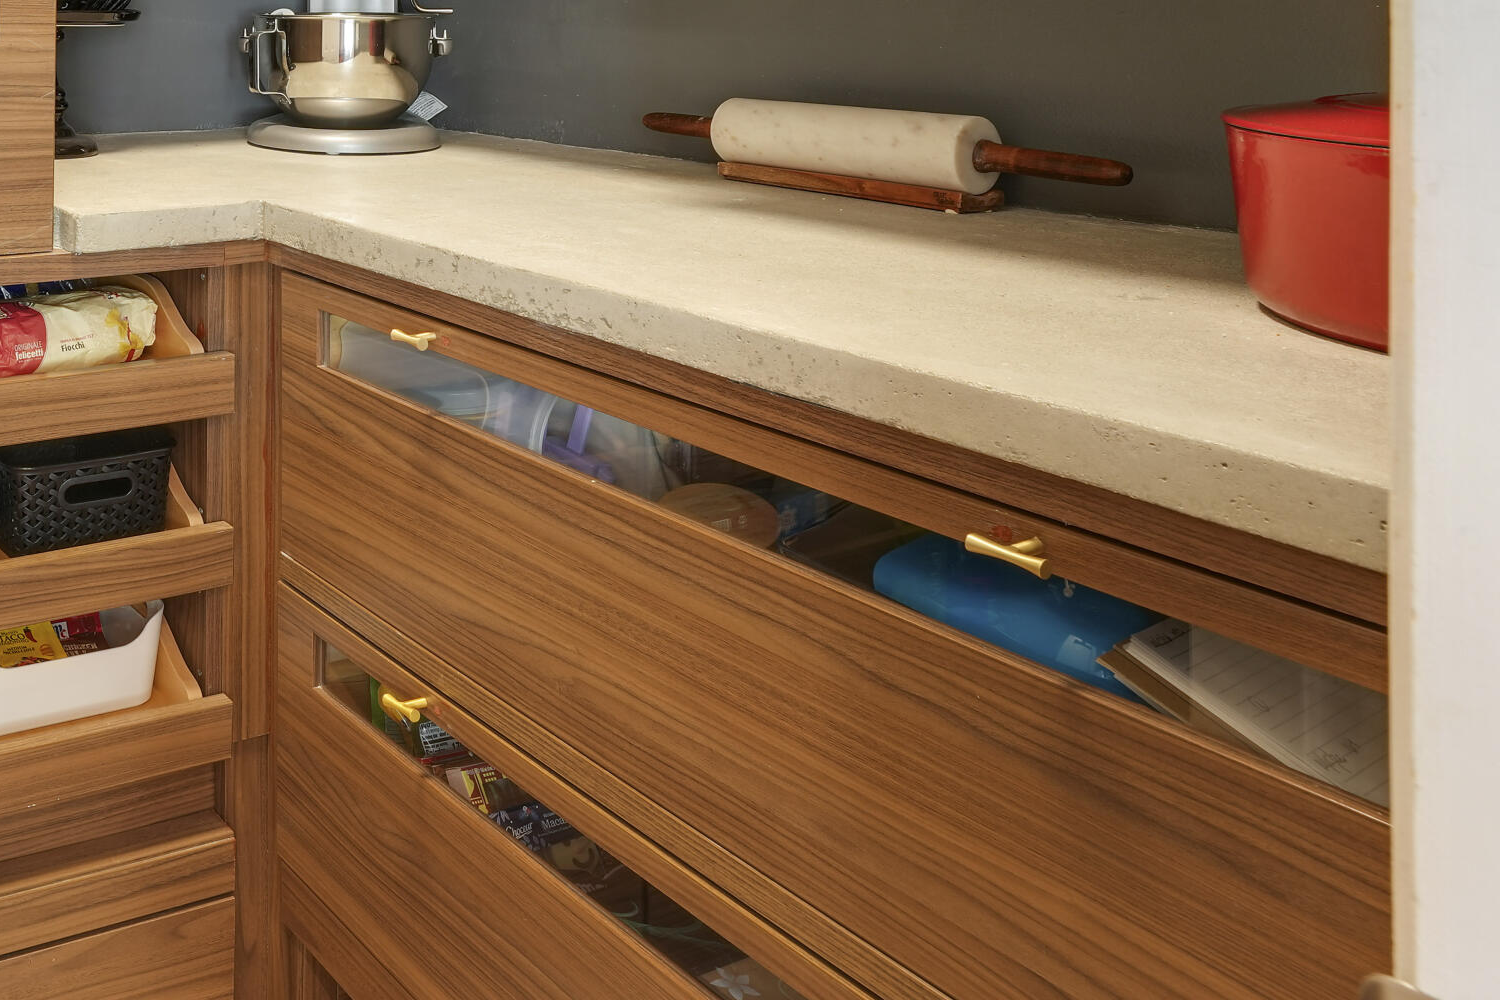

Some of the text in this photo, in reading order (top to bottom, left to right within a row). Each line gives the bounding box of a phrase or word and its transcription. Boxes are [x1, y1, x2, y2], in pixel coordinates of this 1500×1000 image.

[14, 340, 43, 352] ORIGINALE
[61, 341, 85, 352] Fiocchi
[15, 349, 43, 361] felicetti
[0, 632, 26, 642] TACO
[63, 641, 98, 650] CHICKEN
[505, 821, 533, 837] Choceur
